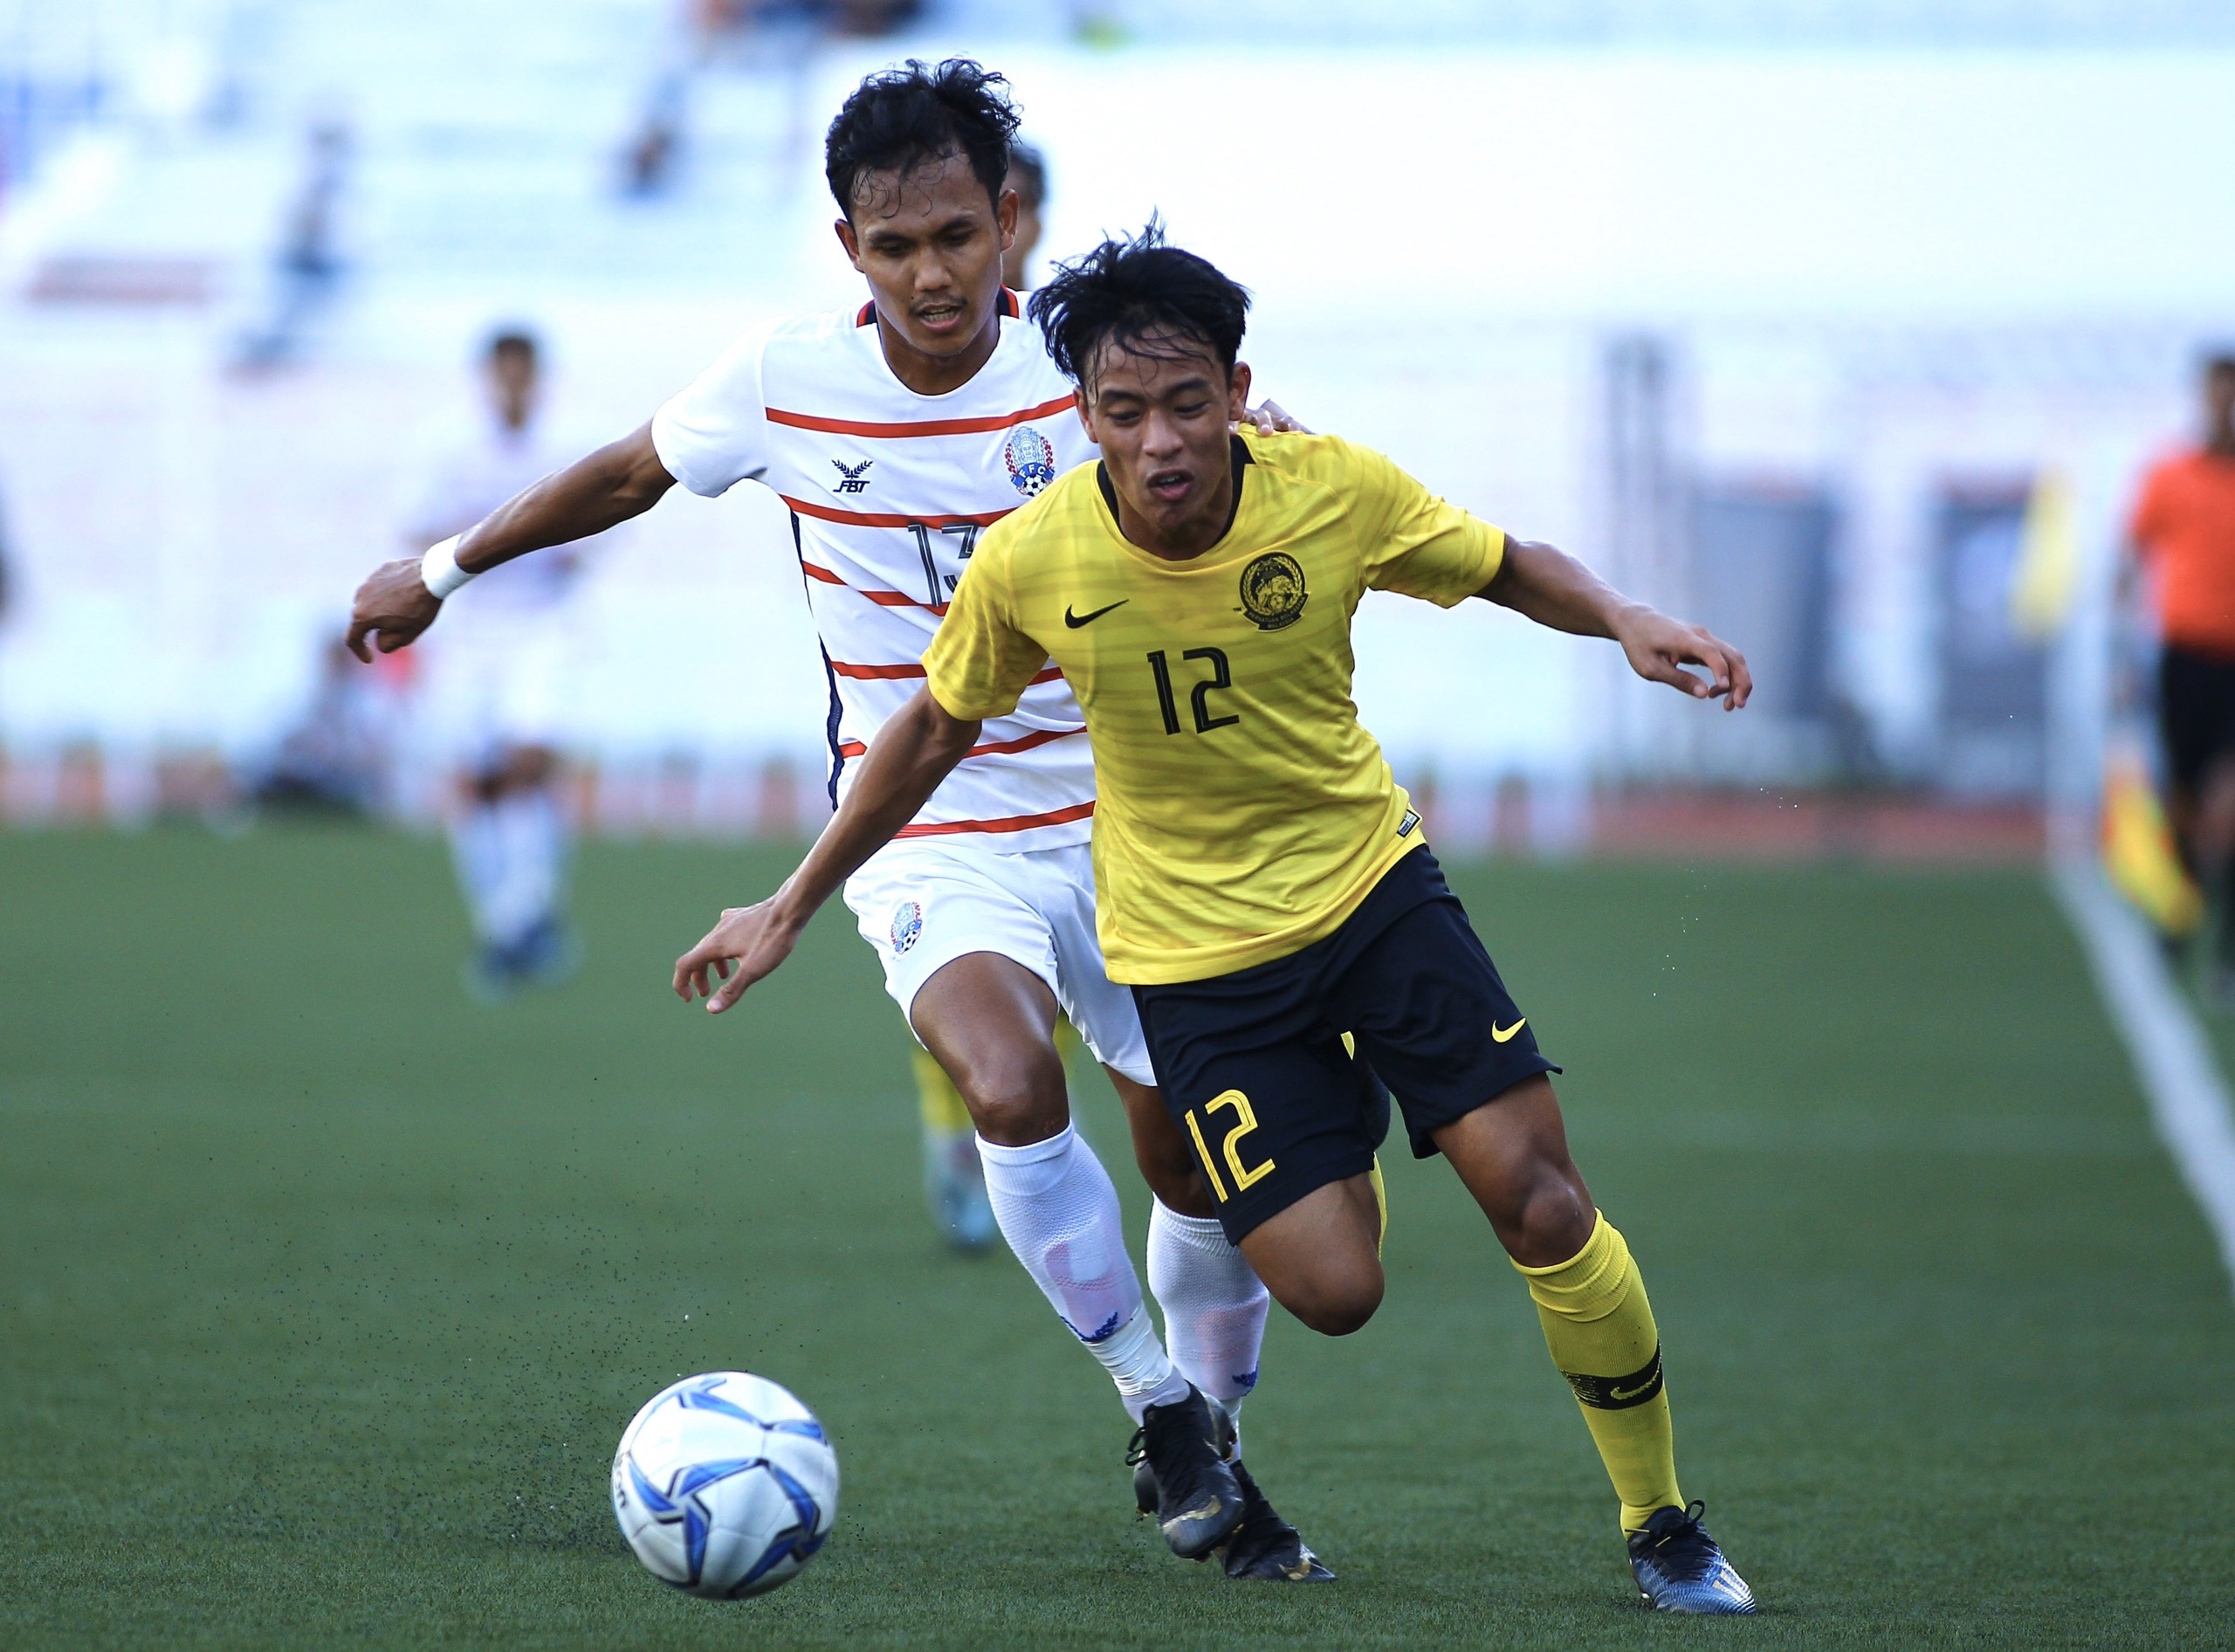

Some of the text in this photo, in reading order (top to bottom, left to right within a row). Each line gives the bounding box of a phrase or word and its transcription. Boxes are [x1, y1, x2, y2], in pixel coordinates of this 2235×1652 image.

[832, 480, 870, 493] FBT
[1019, 465, 1046, 478] FFC
[908, 522, 979, 607] 13
[1146, 647, 1240, 735] 12
[1185, 1089, 1276, 1203] 12
